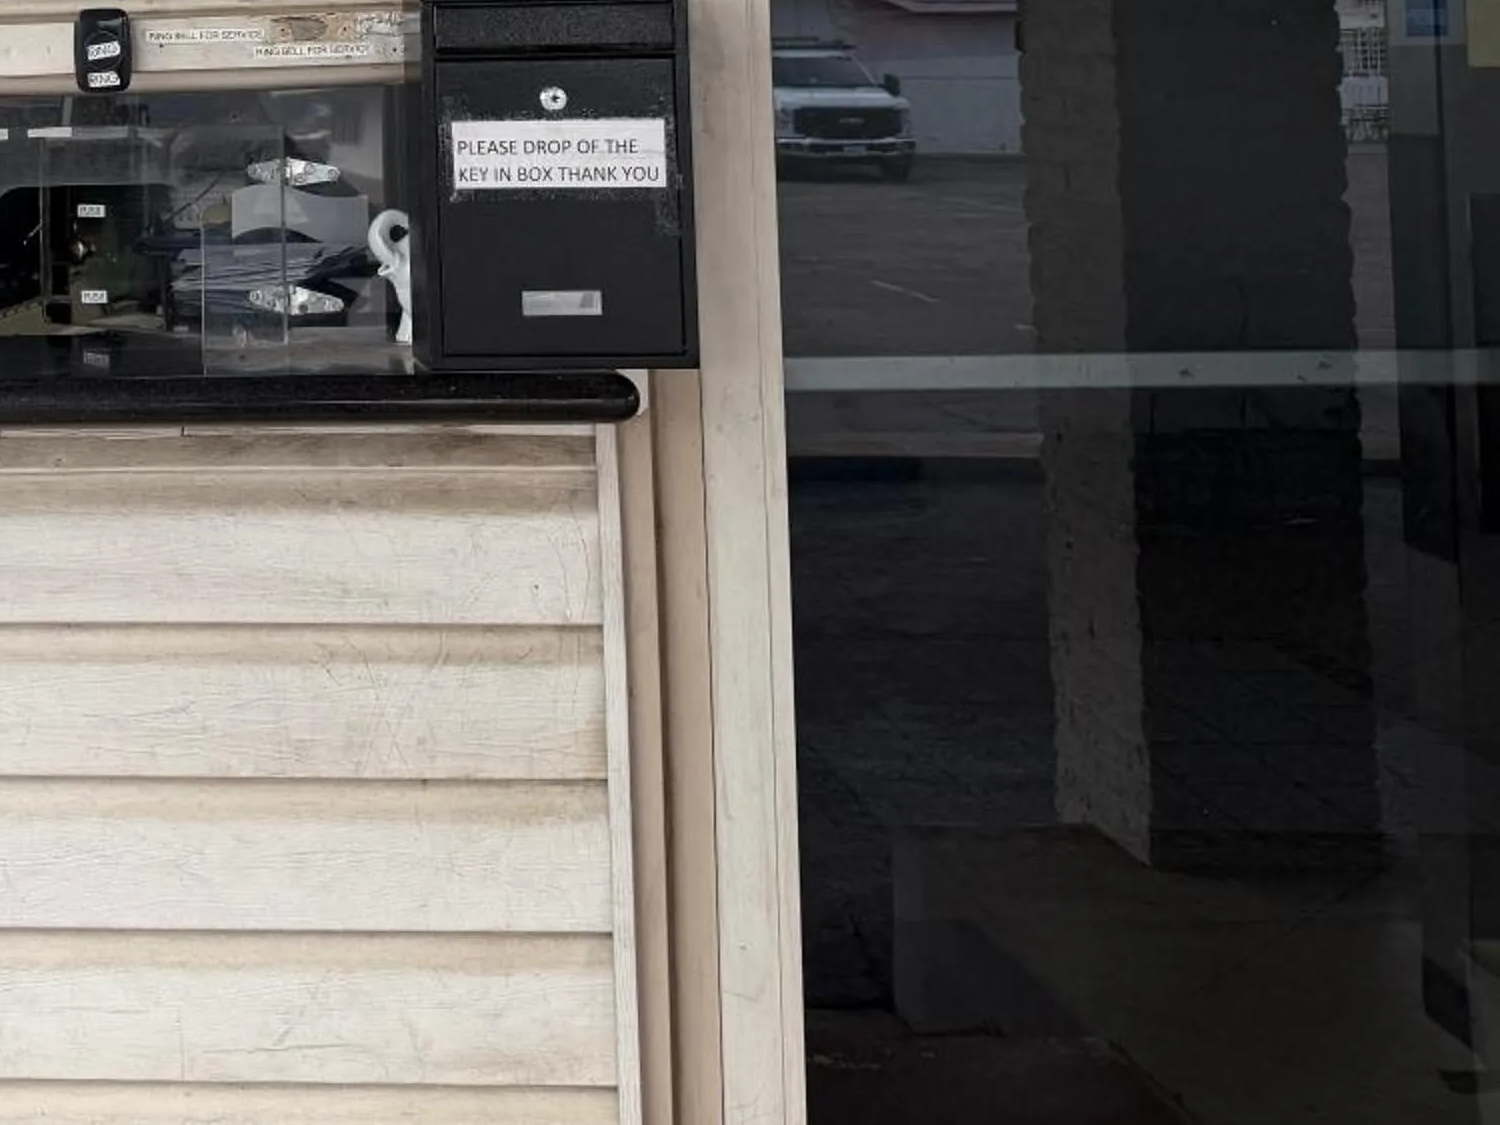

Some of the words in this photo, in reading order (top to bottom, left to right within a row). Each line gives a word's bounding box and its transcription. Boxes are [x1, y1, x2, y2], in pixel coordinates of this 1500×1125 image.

[457, 139, 518, 156] PLEASE
[523, 139, 571, 155] DROP
[577, 139, 599, 155] OF
[605, 138, 638, 154] THE
[459, 167, 488, 182] KEY
[494, 166, 511, 182] IN
[517, 166, 552, 183] BOX
[558, 166, 617, 183] THANK
[622, 166, 660, 182] YOU
